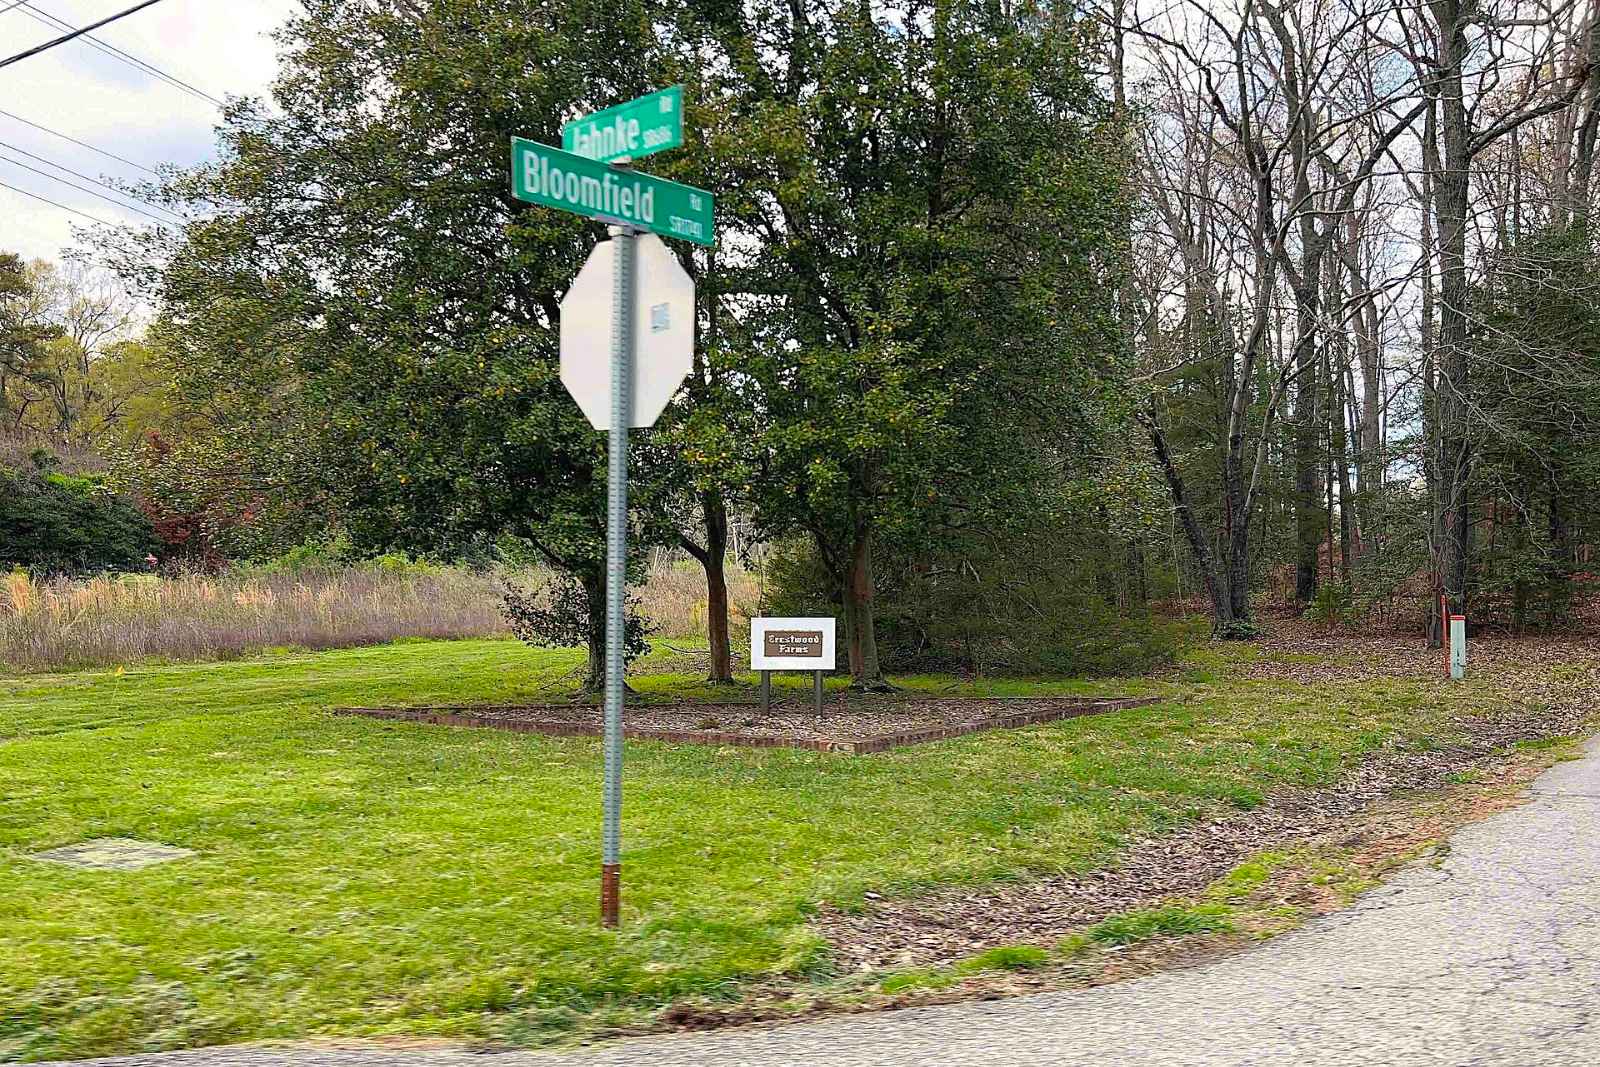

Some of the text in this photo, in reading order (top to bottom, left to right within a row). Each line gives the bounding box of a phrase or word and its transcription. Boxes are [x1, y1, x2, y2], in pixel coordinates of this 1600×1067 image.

[523, 150, 655, 223] Bloomfield
[768, 635, 820, 643] Crestwood
[779, 644, 809, 654] Farms
